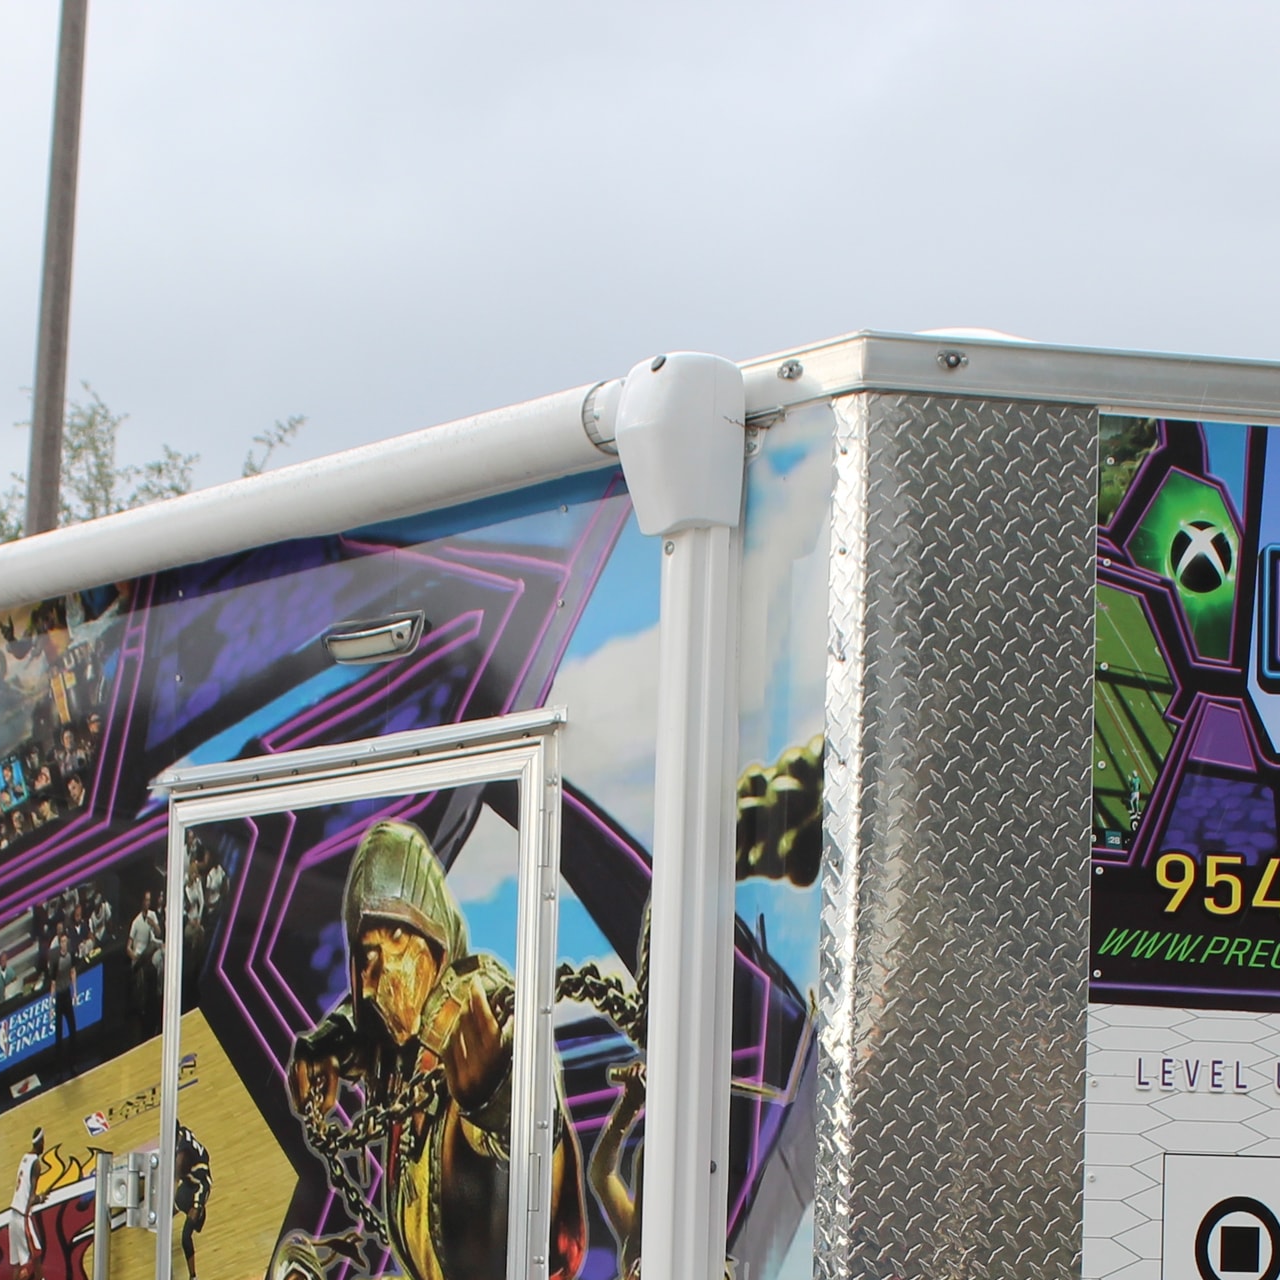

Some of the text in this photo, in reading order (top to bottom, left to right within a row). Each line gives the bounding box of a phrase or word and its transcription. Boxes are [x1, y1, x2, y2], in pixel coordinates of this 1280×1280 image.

[9, 995, 56, 1030] EASTERN
[8, 1020, 56, 1056] FINALS
[1136, 1057, 1249, 1090] LEVEL
